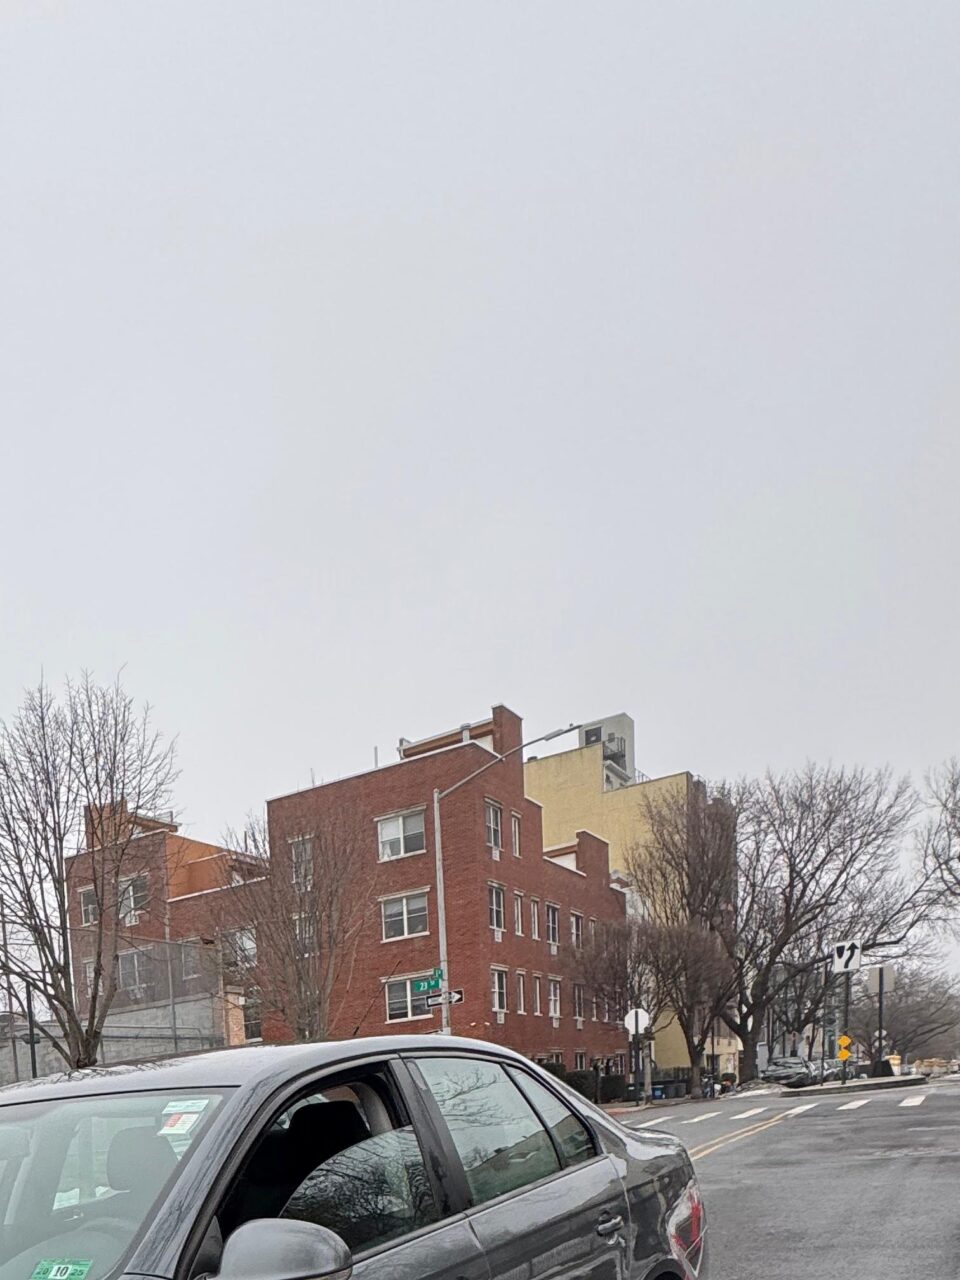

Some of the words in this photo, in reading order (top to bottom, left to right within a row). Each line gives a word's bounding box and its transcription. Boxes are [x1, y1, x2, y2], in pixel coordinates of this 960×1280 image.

[419, 982, 428, 991] 23
[53, 1266, 69, 1277] 10
[70, 1268, 84, 1277] 25
